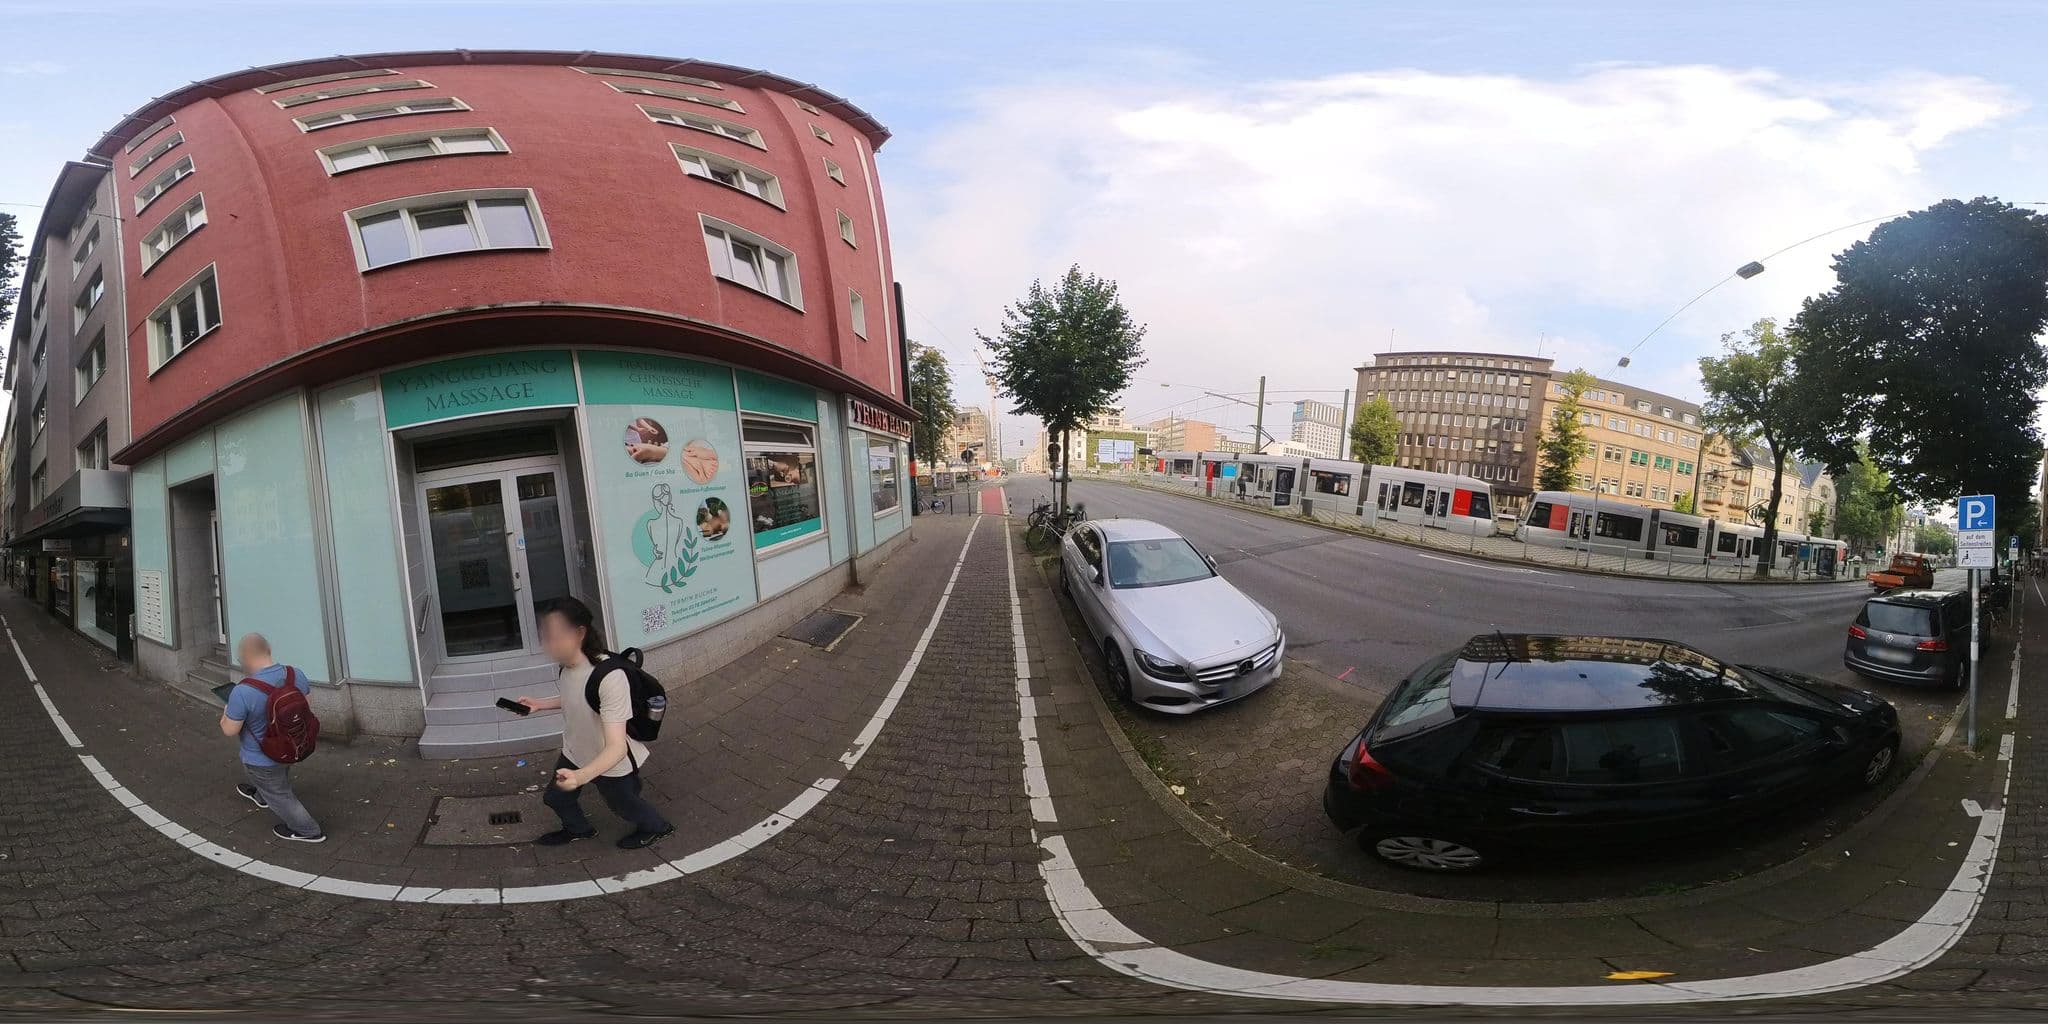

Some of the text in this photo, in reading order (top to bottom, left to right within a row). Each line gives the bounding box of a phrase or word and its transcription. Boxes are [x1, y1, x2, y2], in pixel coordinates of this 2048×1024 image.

[642, 387, 696, 401] MASSAGE
[1966, 500, 1986, 529] P
[2011, 537, 2017, 547] P
